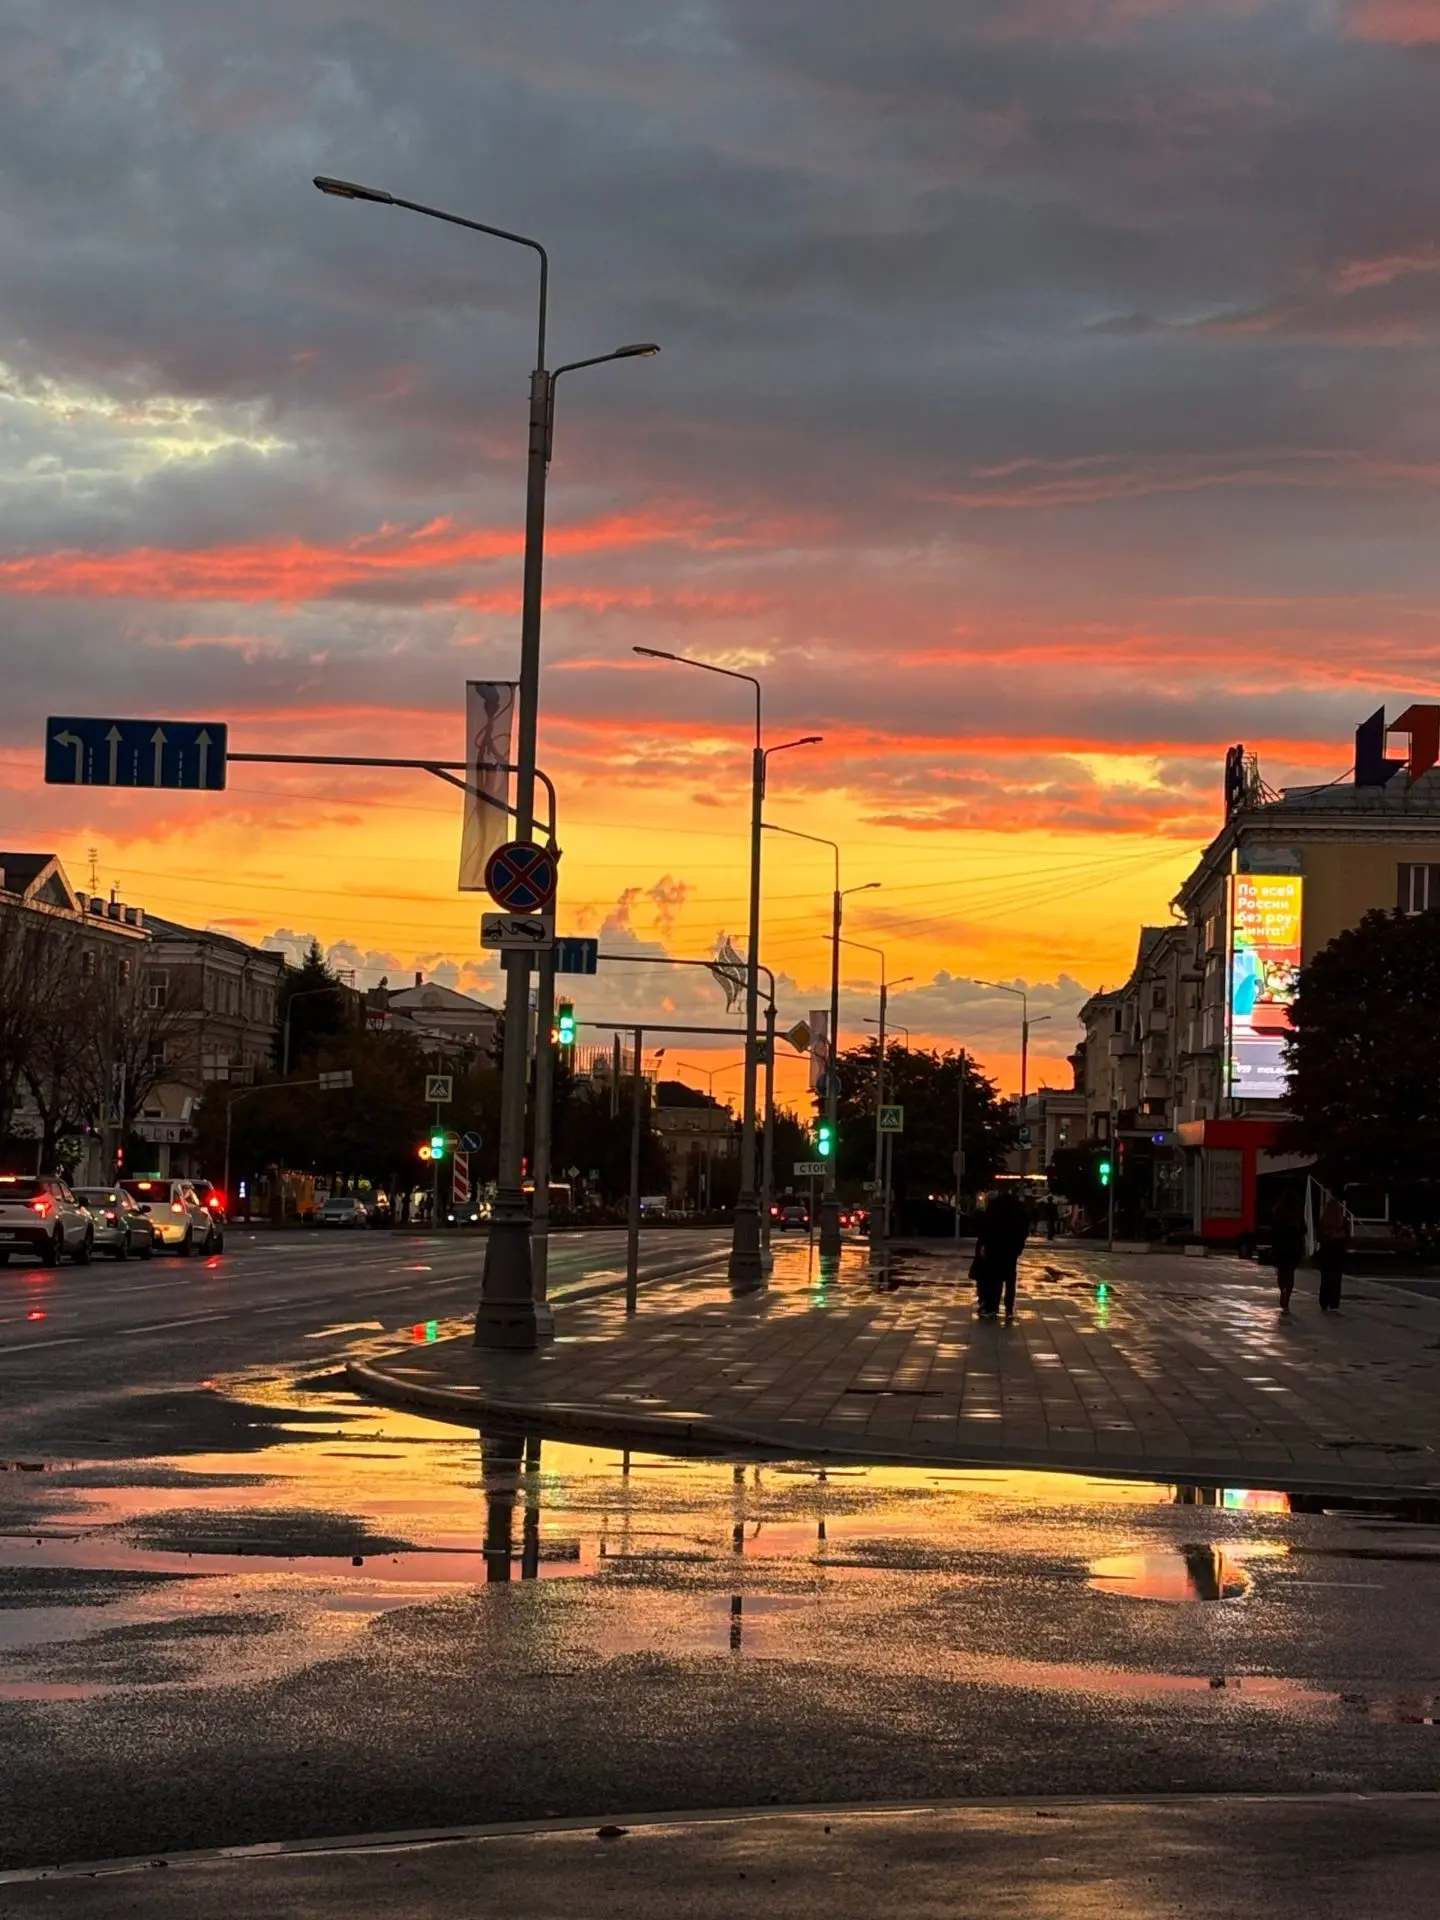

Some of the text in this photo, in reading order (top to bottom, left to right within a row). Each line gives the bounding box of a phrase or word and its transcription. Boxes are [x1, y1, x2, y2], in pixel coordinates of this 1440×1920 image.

[1238, 883, 1294, 897] По всей
[1238, 898, 1290, 909] России
